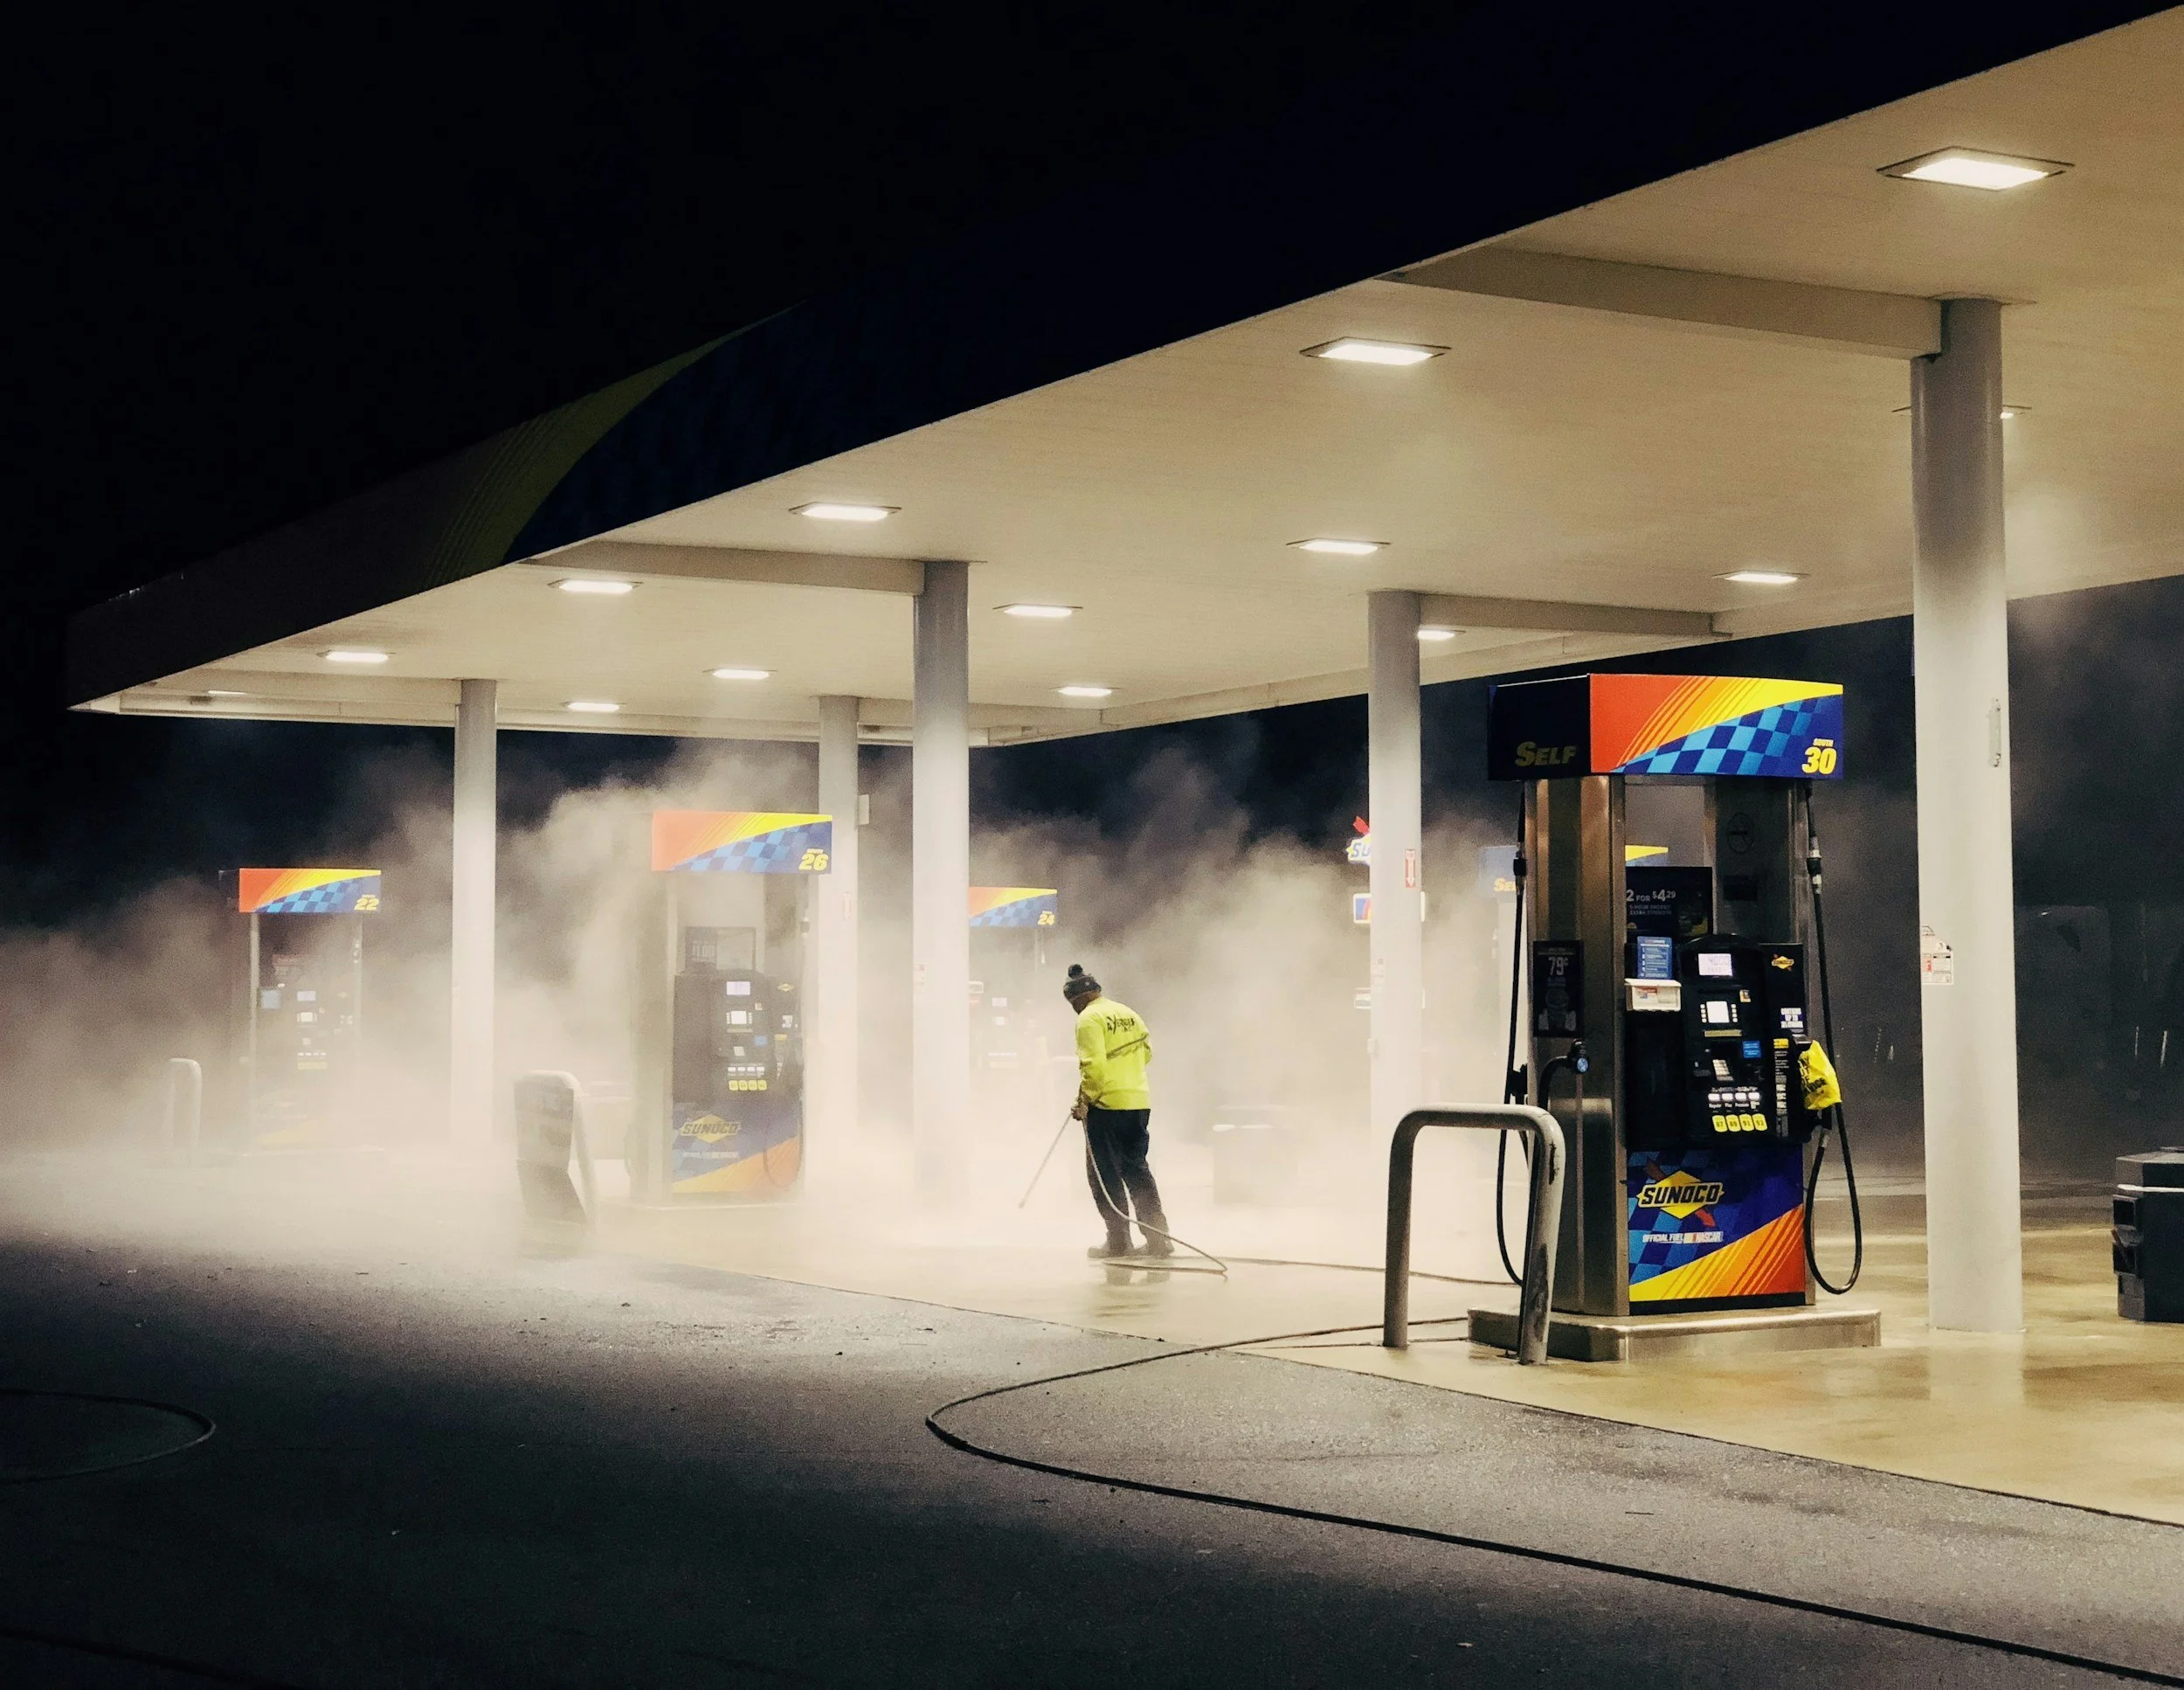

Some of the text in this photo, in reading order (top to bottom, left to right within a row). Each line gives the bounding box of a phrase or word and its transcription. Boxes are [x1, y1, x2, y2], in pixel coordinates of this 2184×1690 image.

[1514, 741, 1577, 766] SELF
[1802, 746, 1836, 774] 30
[798, 853, 828, 870] 26
[1626, 889, 1635, 902] 2
[354, 897, 380, 911] 22
[681, 1123, 739, 1134] SUNOCO
[1641, 1185, 1721, 1205] SUNOCO
[1642, 1231, 1724, 1243] OFFICIAL FUEL NASCAR
